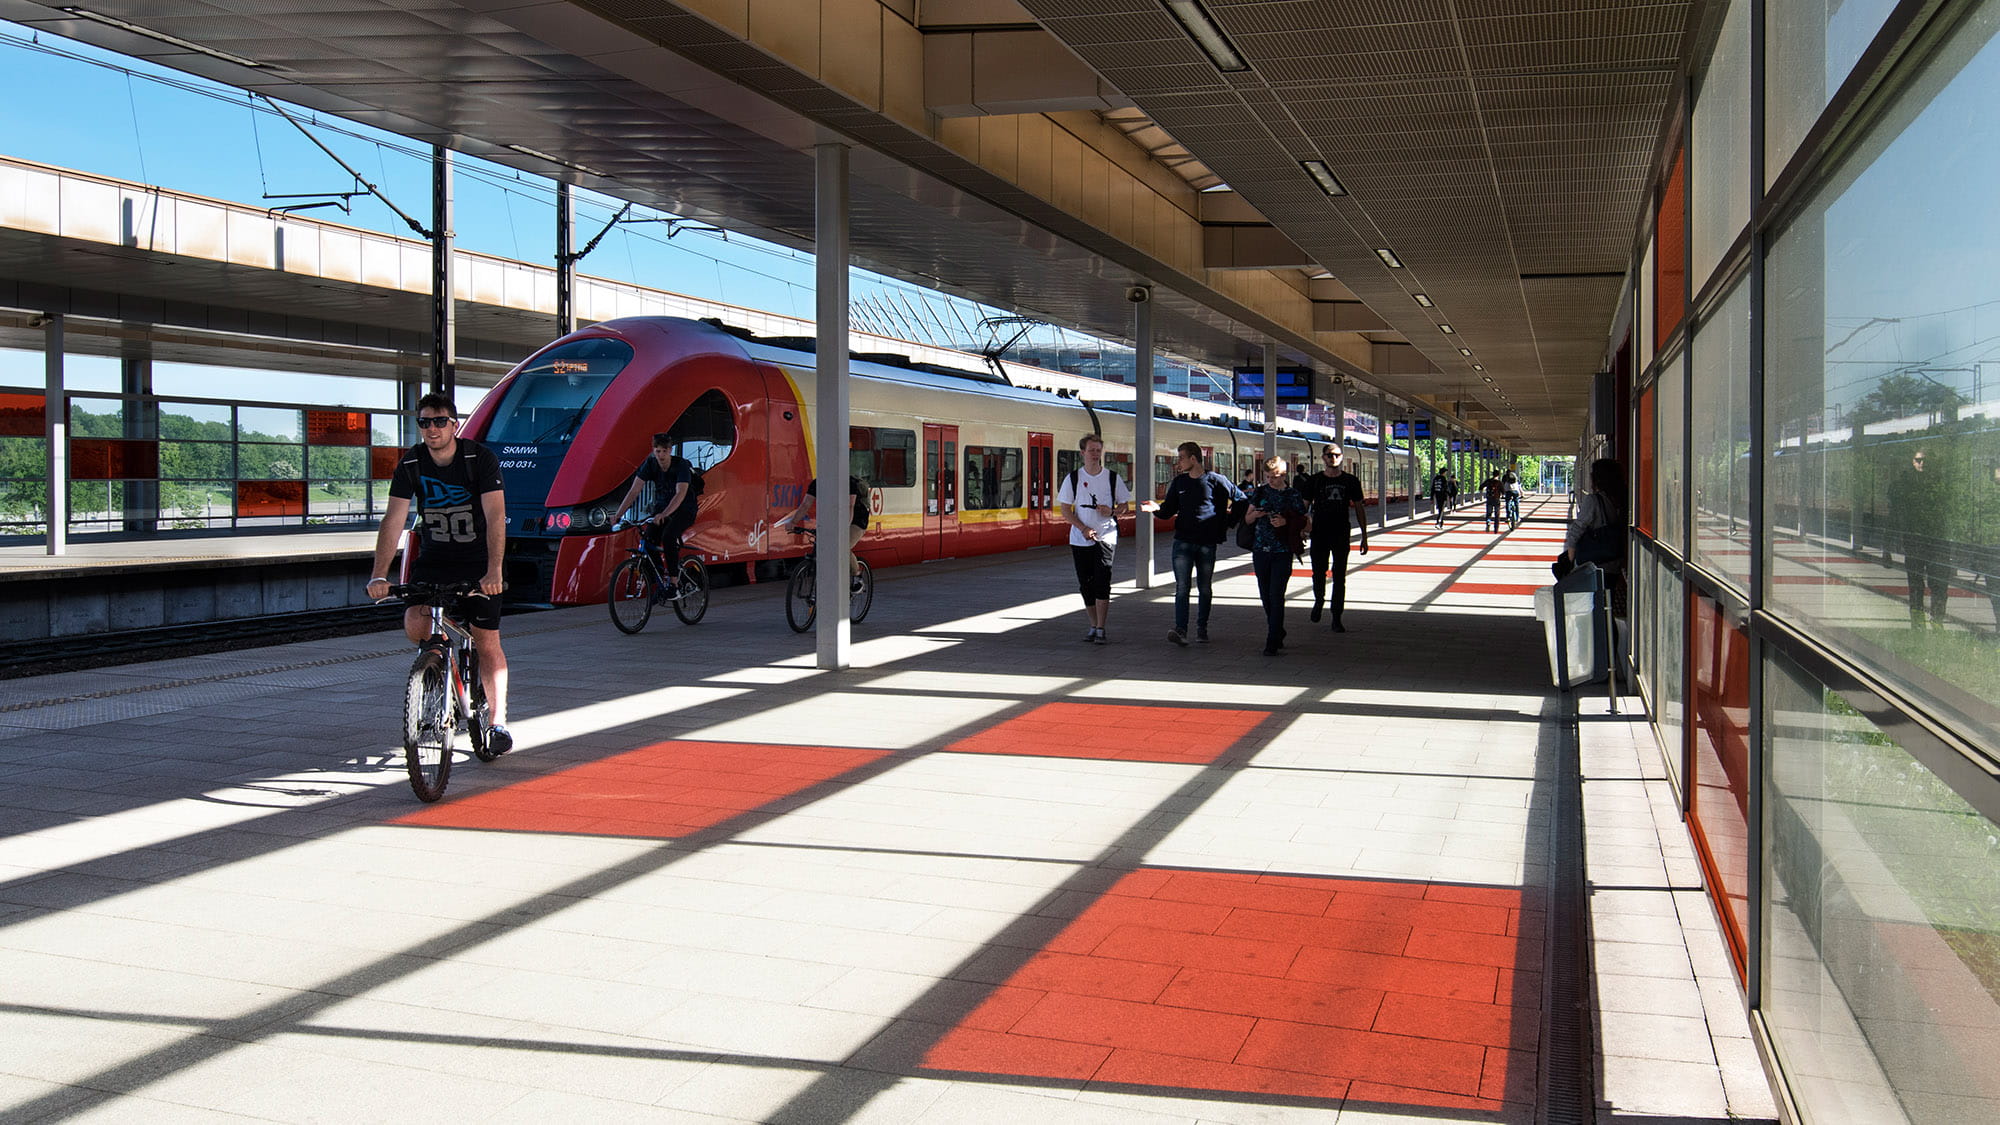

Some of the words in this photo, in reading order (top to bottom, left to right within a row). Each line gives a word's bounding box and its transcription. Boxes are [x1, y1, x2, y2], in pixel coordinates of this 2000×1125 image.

[502, 446, 538, 454] SKMWA
[499, 460, 515, 468] 160
[771, 484, 804, 508] SKM
[748, 519, 767, 553] elf
